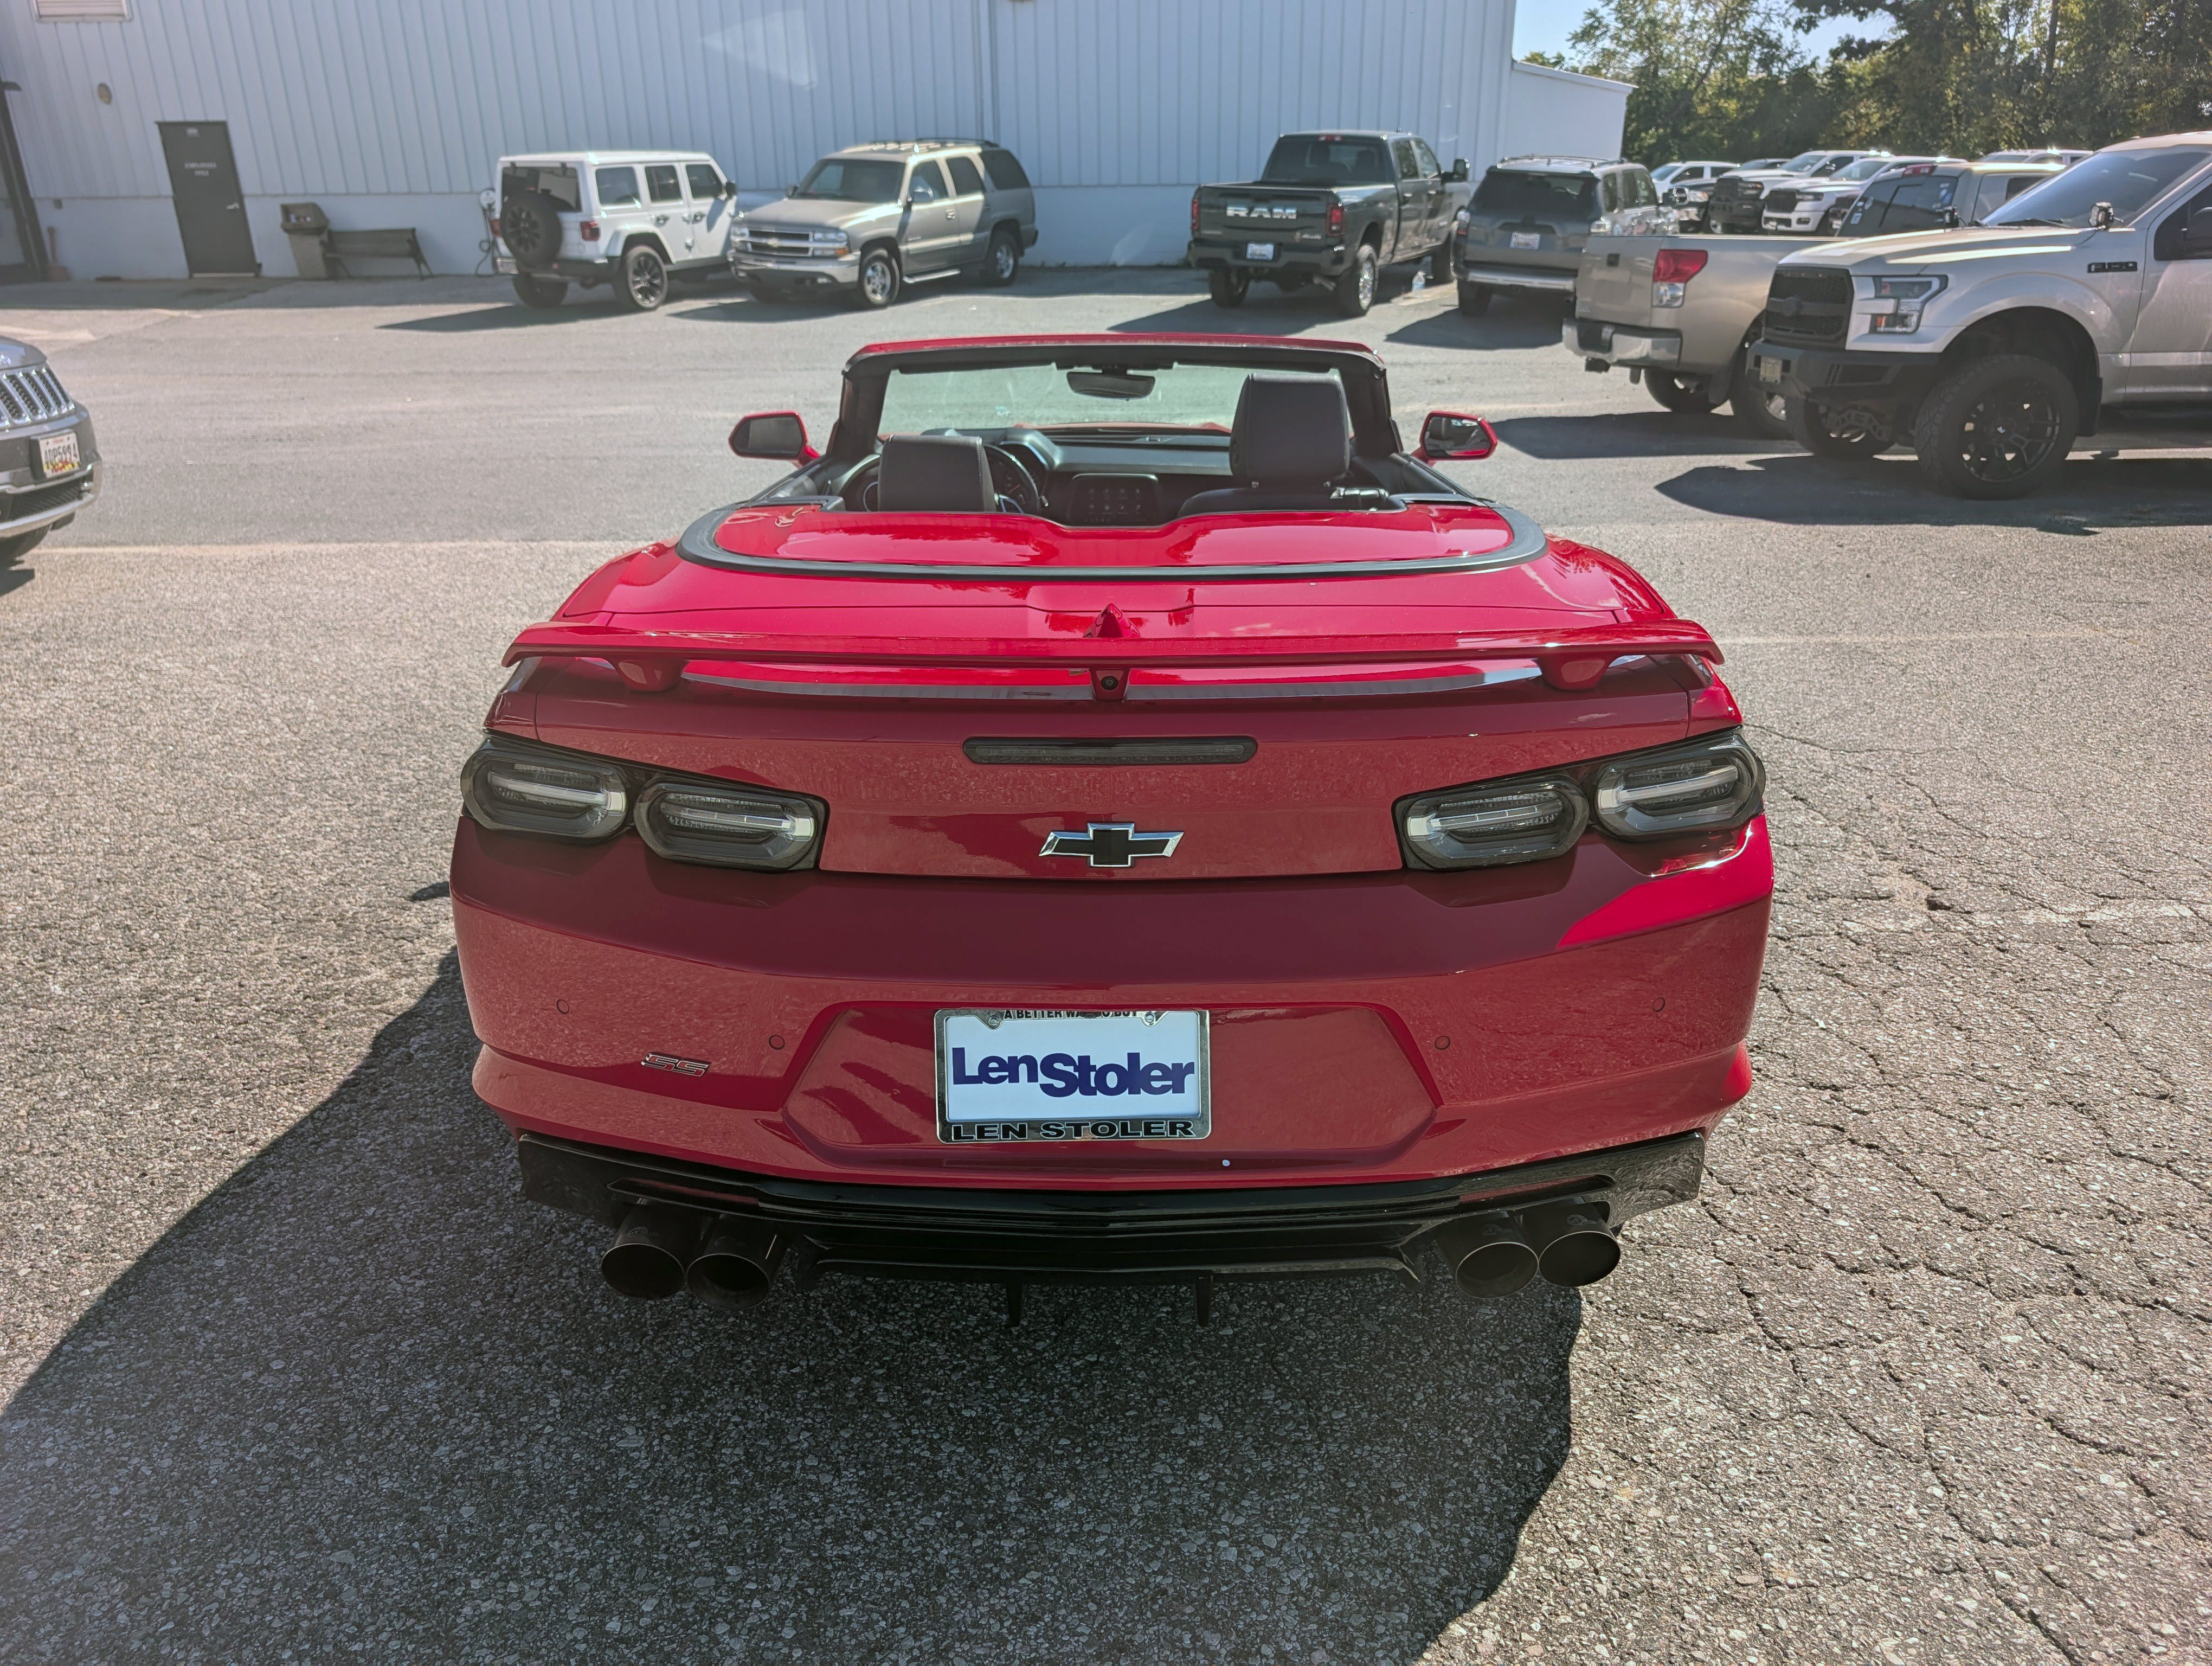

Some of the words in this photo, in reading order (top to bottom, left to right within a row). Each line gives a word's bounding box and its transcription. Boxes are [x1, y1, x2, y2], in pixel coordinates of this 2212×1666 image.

[1226, 207, 1297, 220] RAM
[1004, 1010, 1013, 1019] A
[951, 1123, 1028, 1141] LEN
[1039, 1120, 1197, 1138] STOLER
